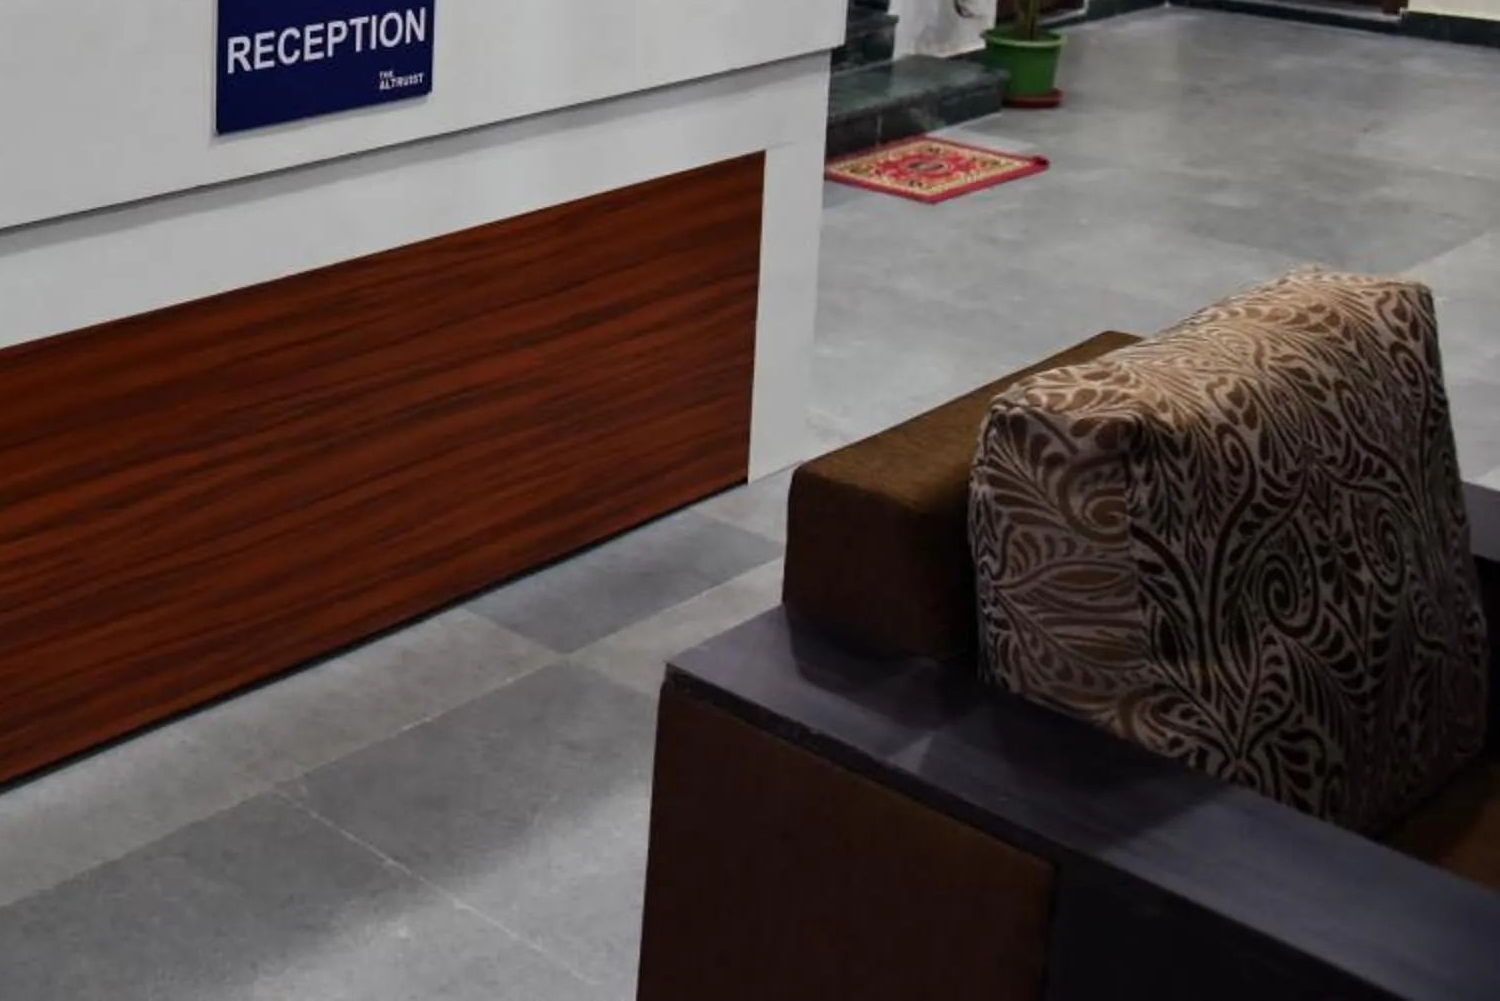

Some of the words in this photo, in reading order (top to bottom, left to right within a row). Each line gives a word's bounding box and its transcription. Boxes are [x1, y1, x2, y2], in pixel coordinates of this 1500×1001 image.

[227, 7, 426, 74] RECEPTION
[379, 70, 394, 79] THE
[379, 72, 425, 91] ALTRUIST
